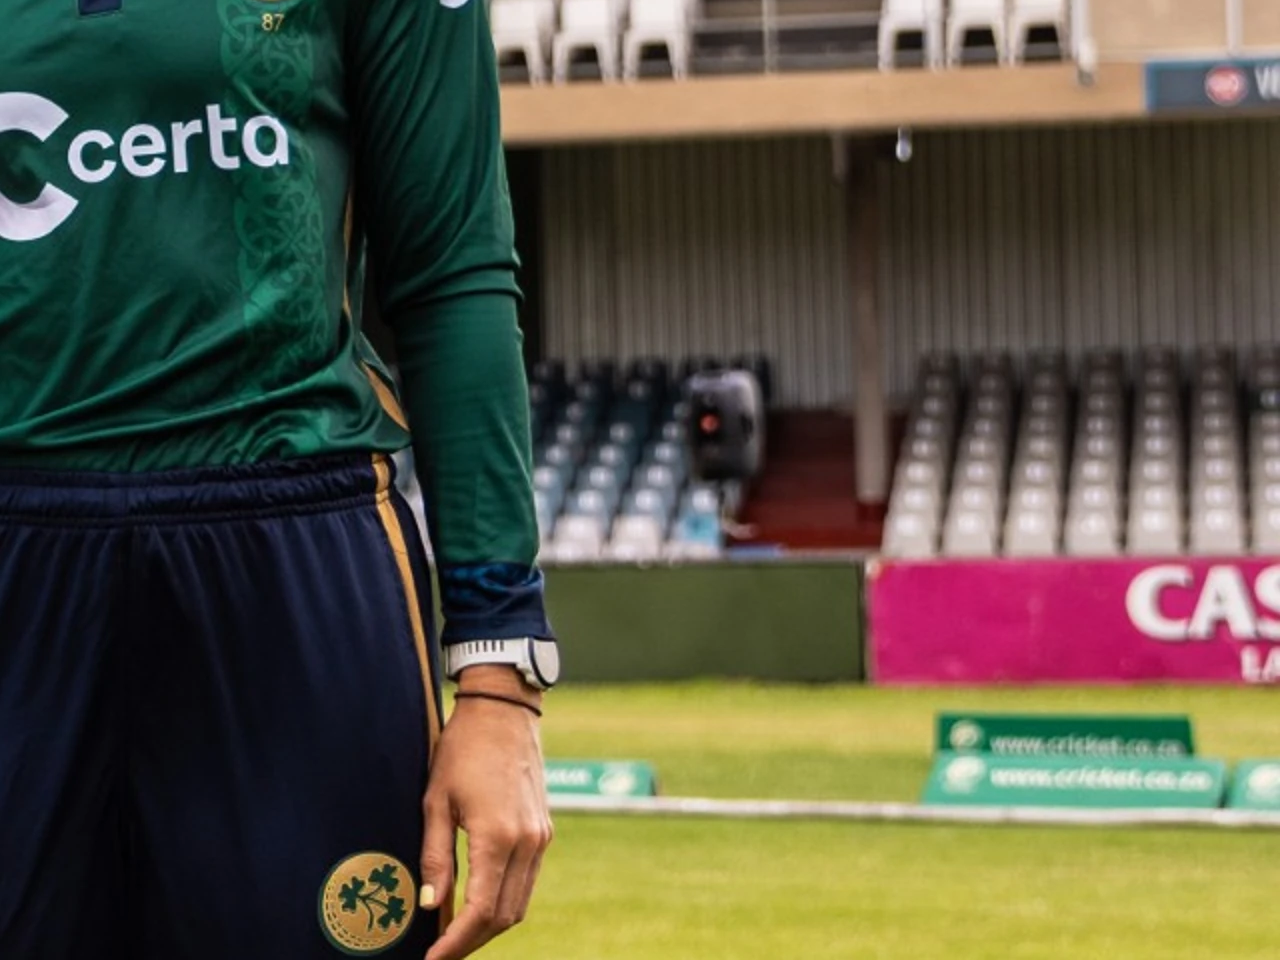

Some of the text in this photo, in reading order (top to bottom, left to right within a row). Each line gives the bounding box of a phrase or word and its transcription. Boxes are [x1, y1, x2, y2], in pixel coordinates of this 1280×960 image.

[261, 14, 285, 32] 87
[67, 103, 290, 183] certa
[991, 765, 1212, 791] www.cricket.co.za
